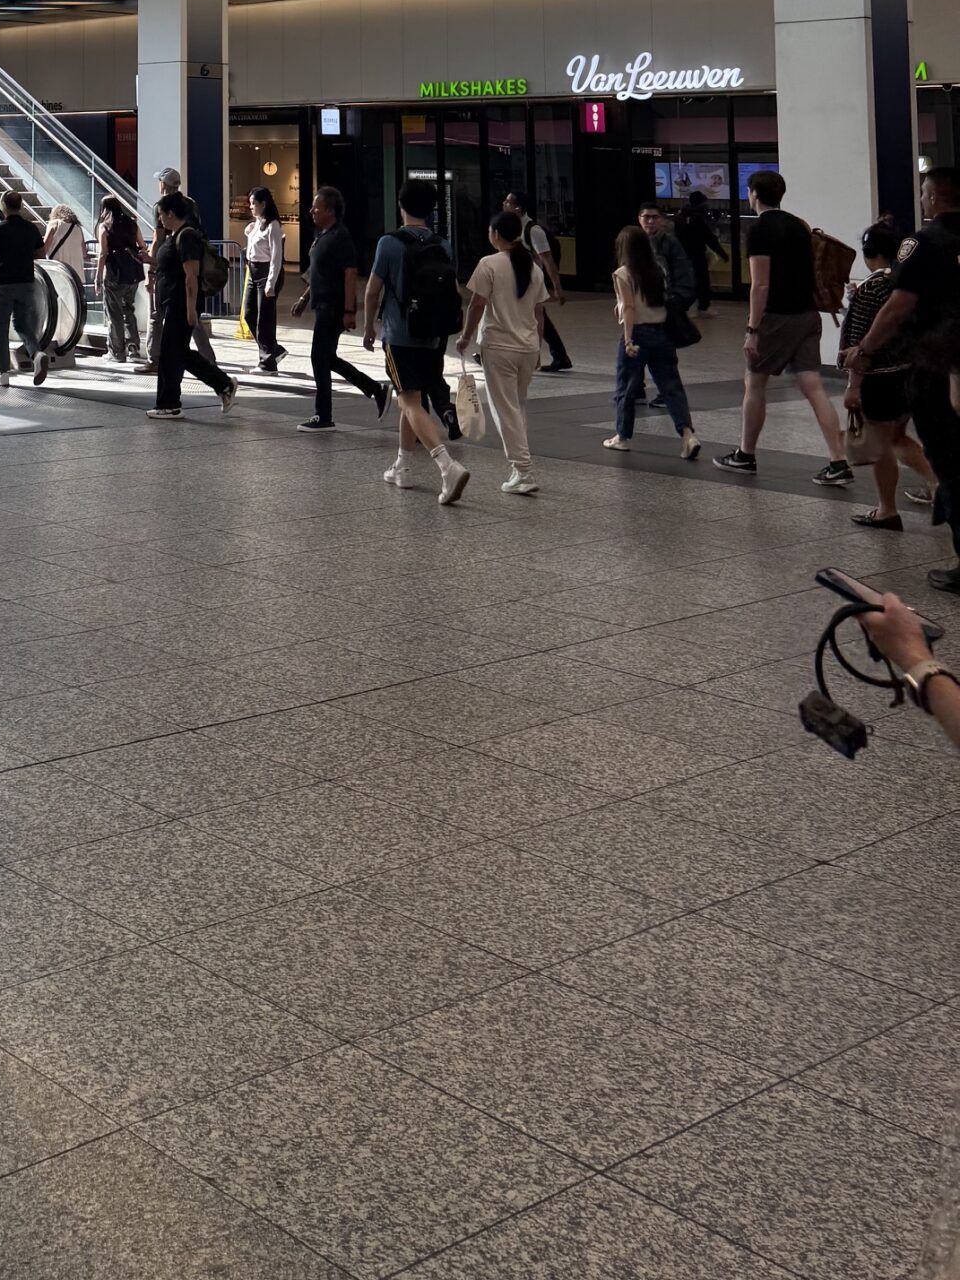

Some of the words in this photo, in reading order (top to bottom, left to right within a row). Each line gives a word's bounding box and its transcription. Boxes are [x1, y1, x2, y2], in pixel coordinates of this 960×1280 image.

[419, 79, 529, 98] MILKSHAKES
[566, 54, 626, 93] Van
[616, 51, 744, 101] Leeuwen
